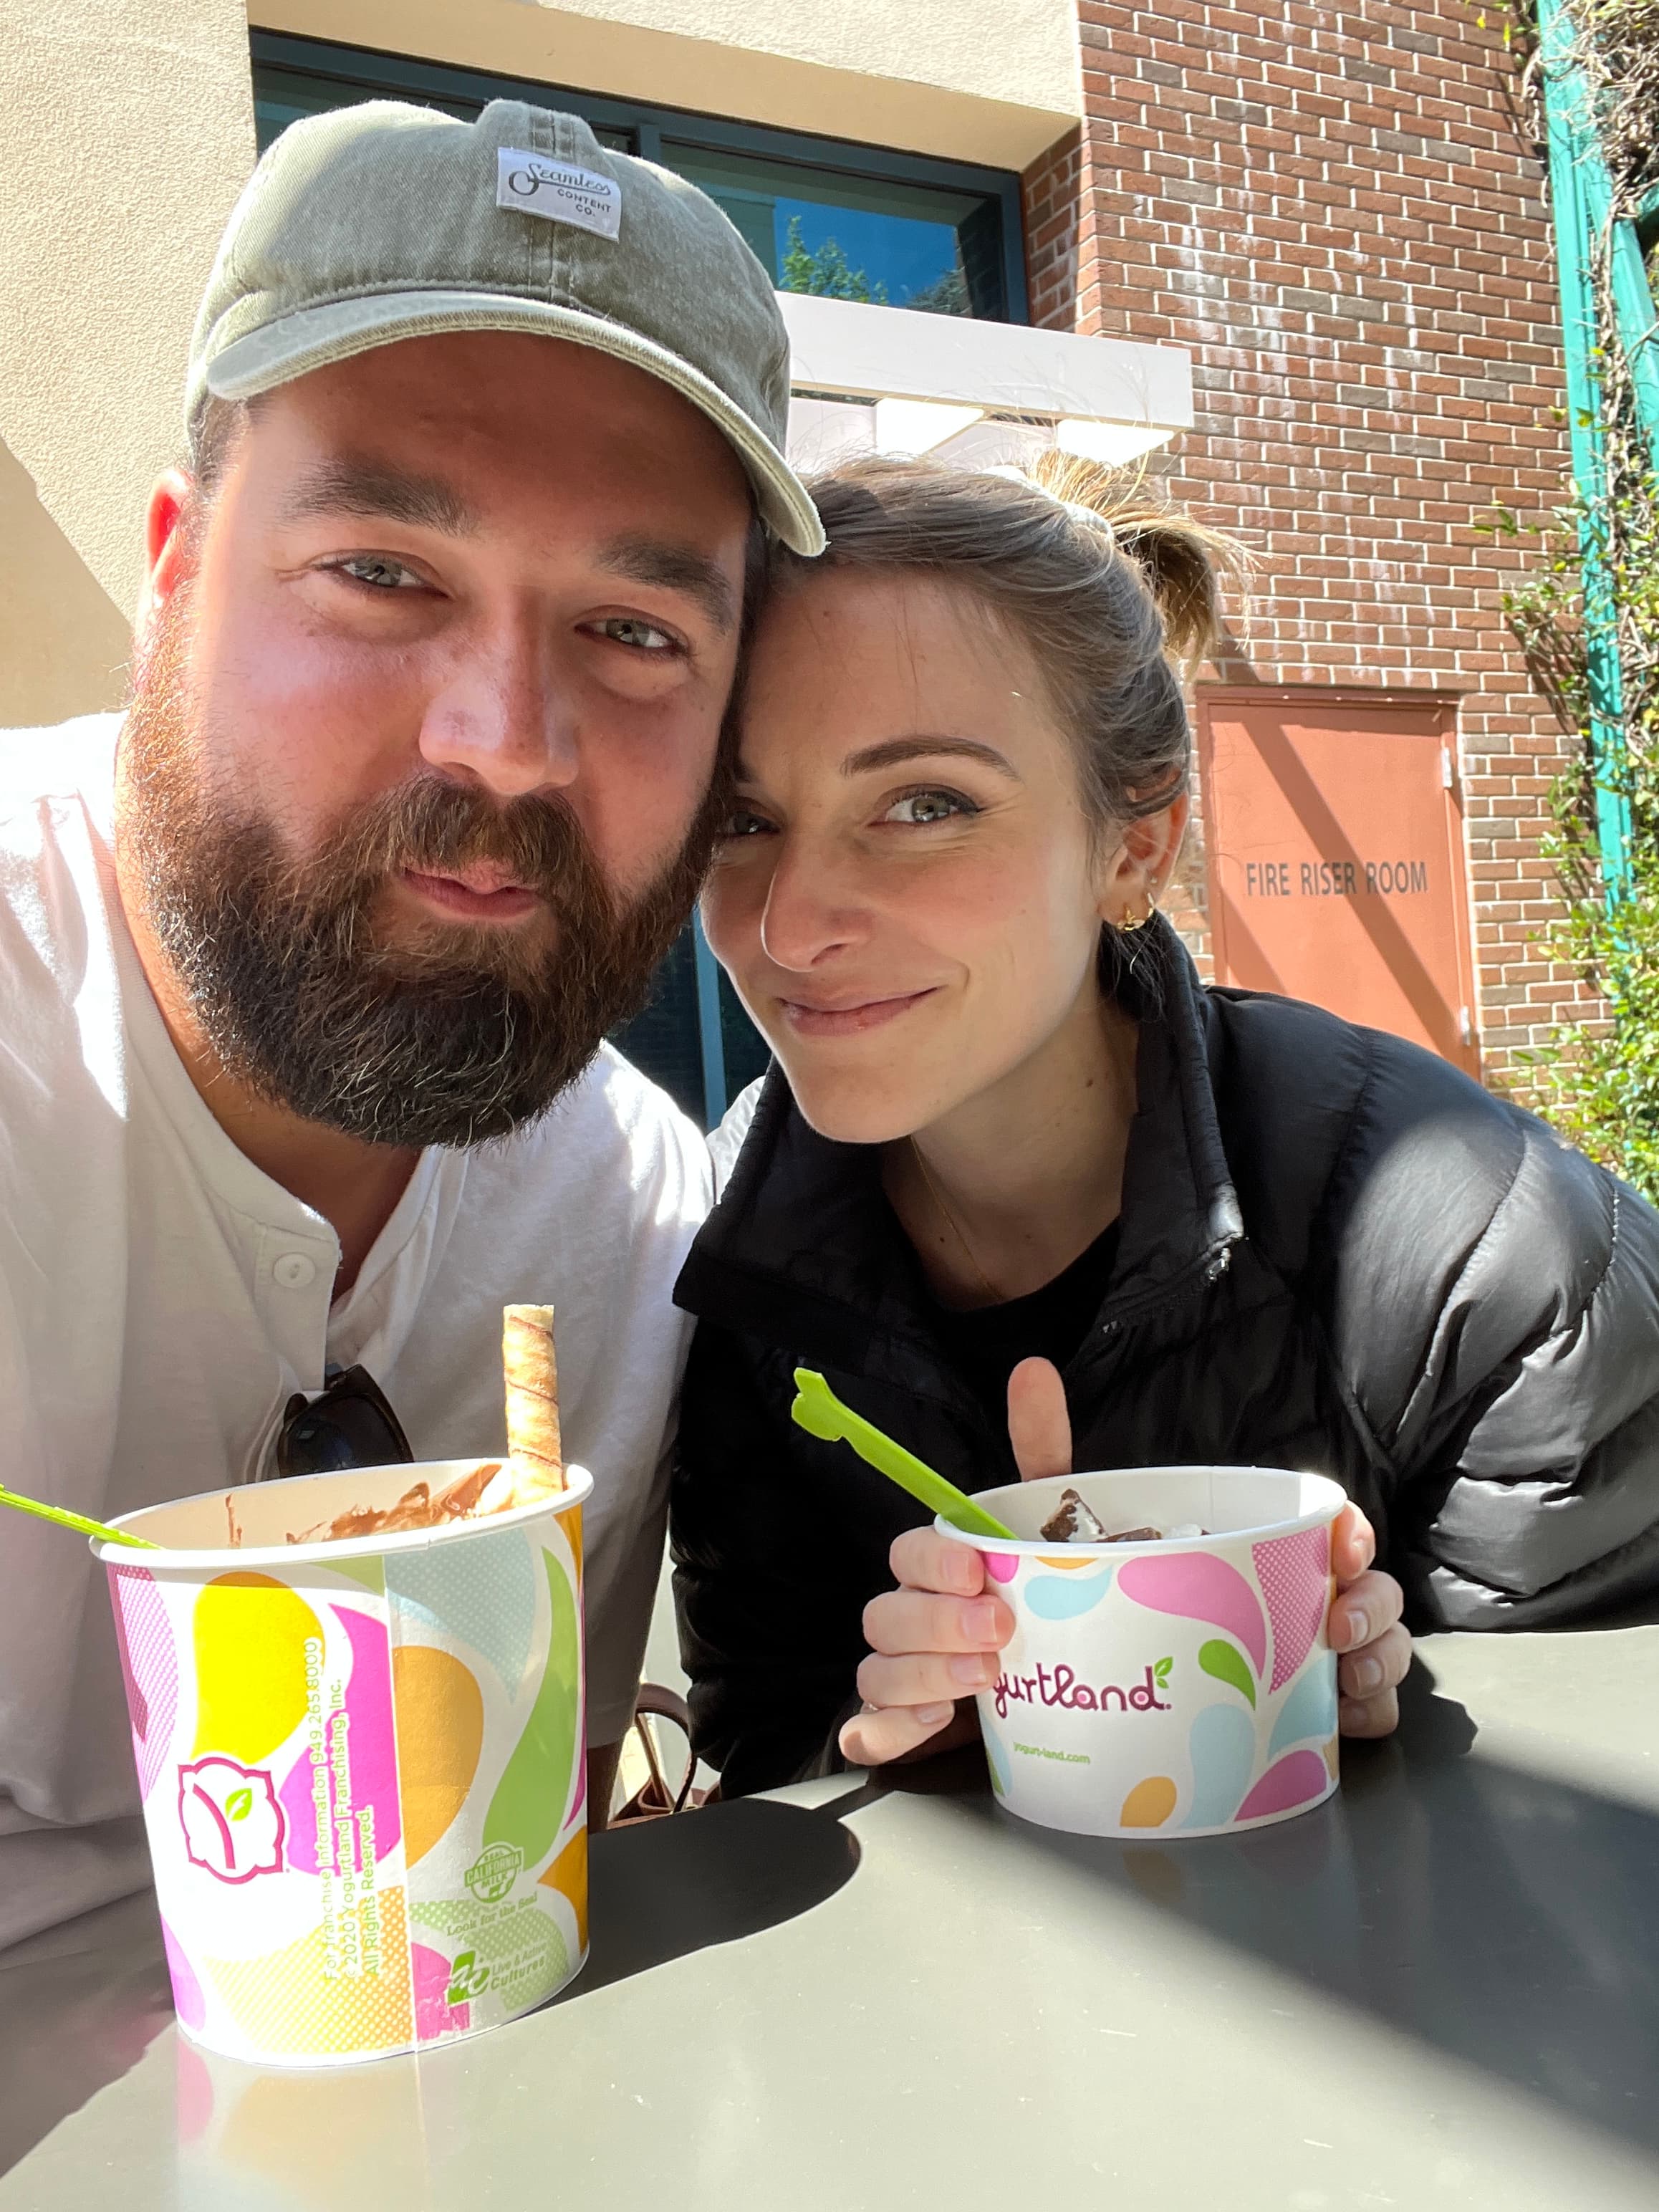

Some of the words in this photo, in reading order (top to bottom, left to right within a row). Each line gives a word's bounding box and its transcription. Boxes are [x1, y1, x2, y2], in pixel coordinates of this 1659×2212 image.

[509, 163, 611, 196] Seamless
[557, 188, 611, 213] CONTENT
[575, 204, 595, 217] CO.
[1246, 862, 1291, 896] FIRE
[1300, 862, 1357, 895] RISER
[1365, 861, 1428, 895] ROOM
[304, 1642, 324, 1763] 949.265.8000
[329, 1679, 342, 1708] Inc.
[314, 1768, 330, 1865] information
[359, 1807, 374, 1890] Reserved.
[338, 1821, 356, 1915] Yogurtland
[466, 1851, 521, 1886] CALIFORNIA
[481, 1872, 509, 1889] MILK
[321, 1871, 334, 1945] franchise
[363, 1895, 380, 1950] Rights
[447, 1918, 477, 1936] Look
[481, 1913, 497, 1925] for
[500, 1904, 516, 1918] the
[342, 1922, 357, 1965] 2020
[324, 1954, 337, 1981] For
[365, 1954, 380, 1976] All
[490, 1955, 546, 1991] Cultures
[492, 1960, 513, 1976] Live
